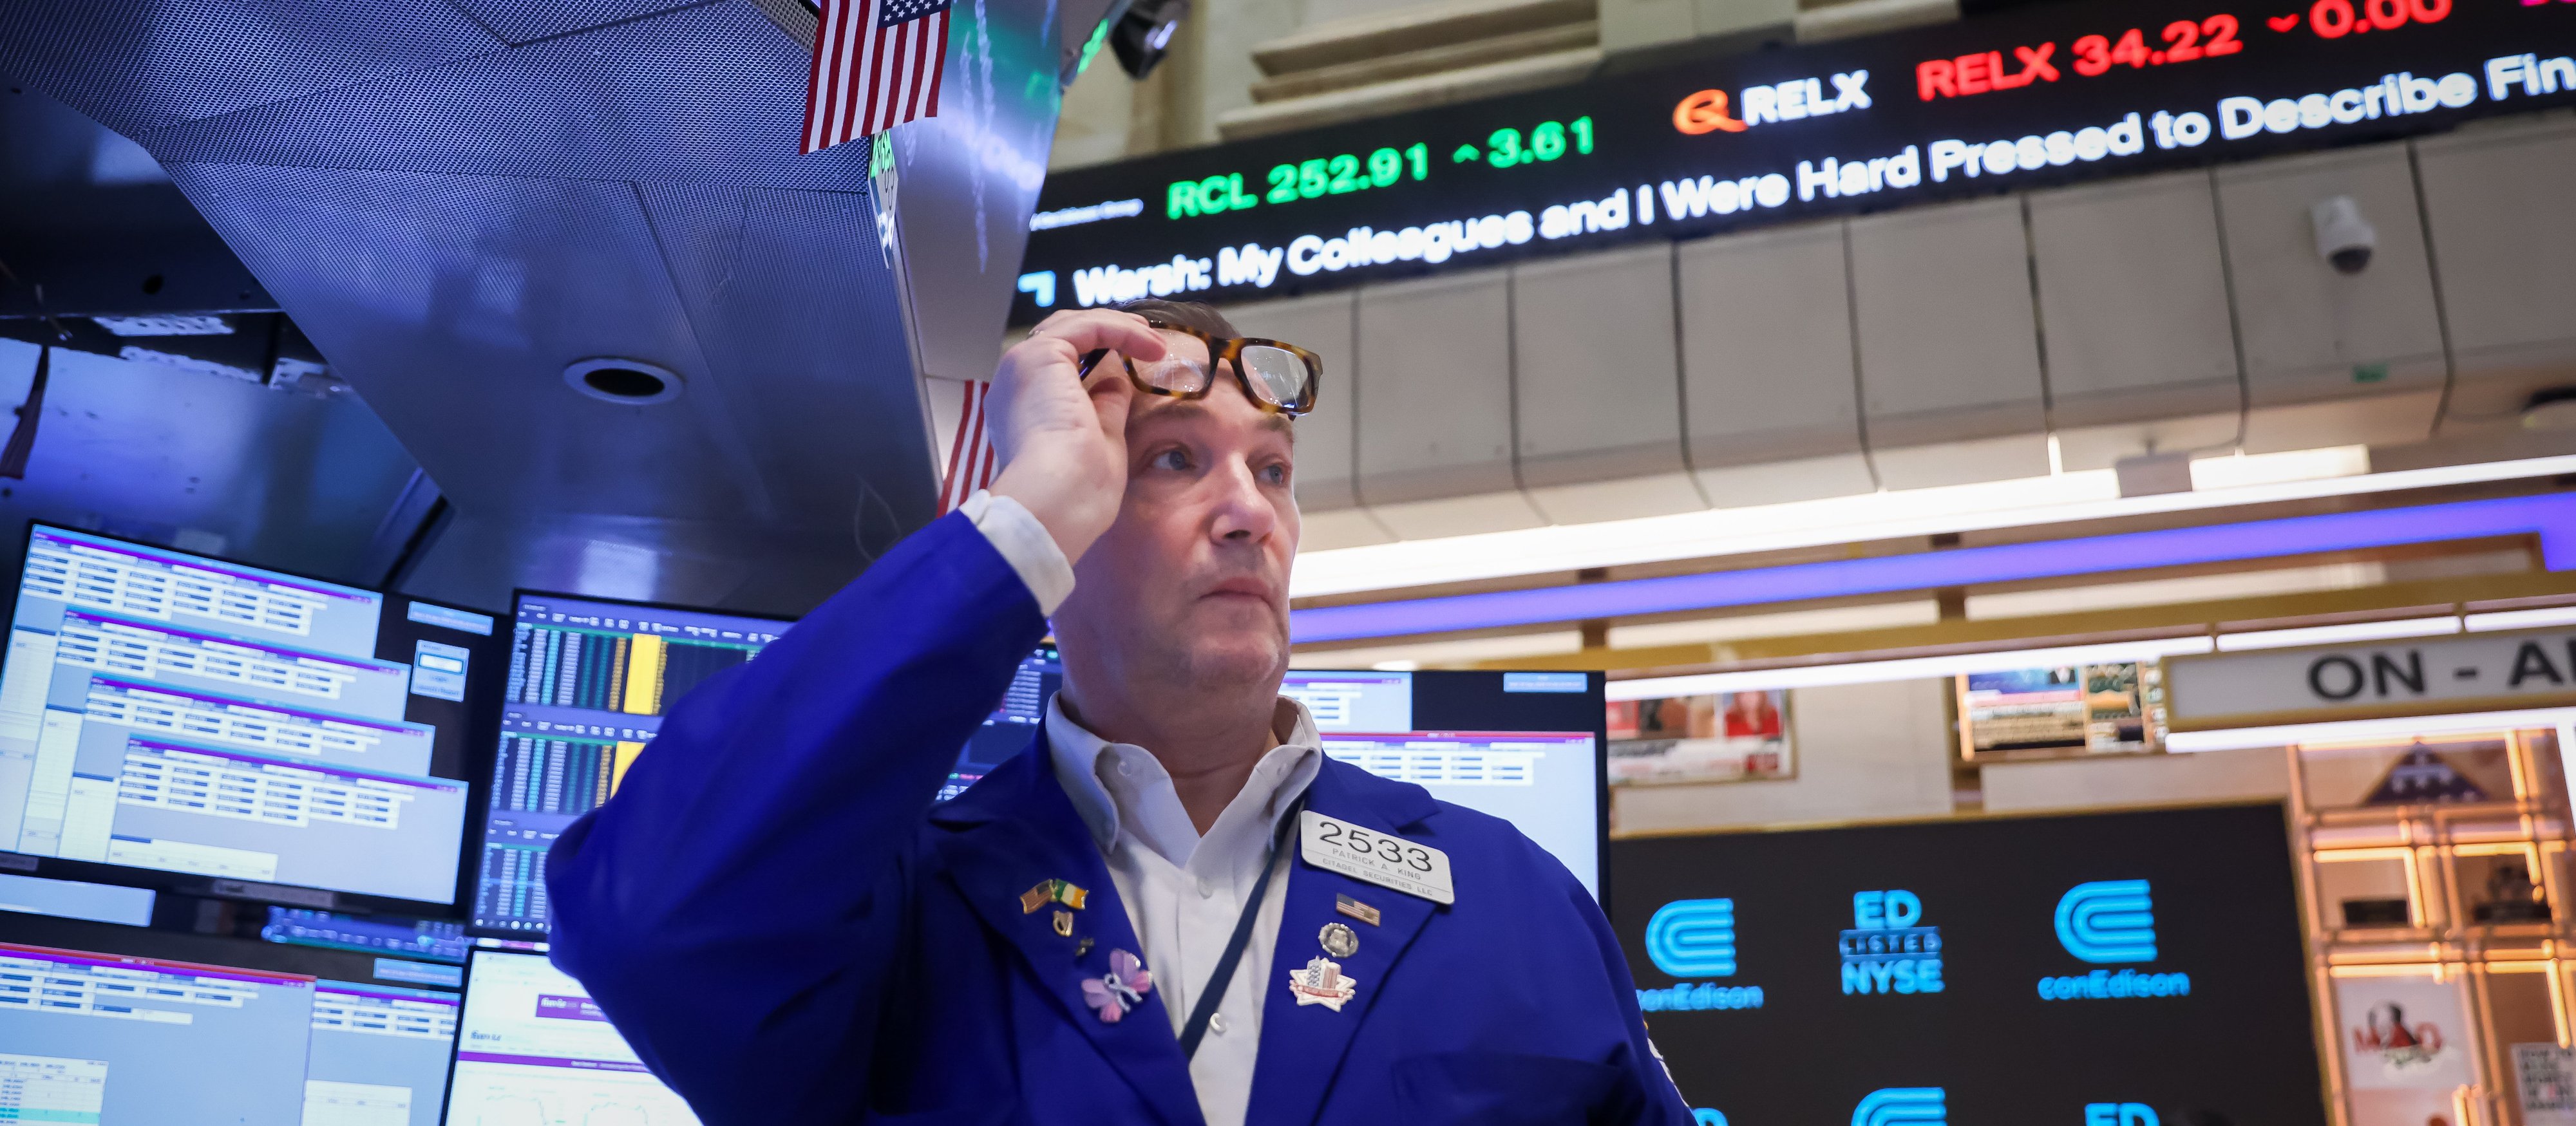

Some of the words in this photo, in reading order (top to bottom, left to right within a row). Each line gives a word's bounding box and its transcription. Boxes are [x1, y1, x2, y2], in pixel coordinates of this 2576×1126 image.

[1916, 41, 2060, 101] RELX
[2072, 14, 2242, 77] 34.22
[2309, 0, 2453, 39] 0.00
[1741, 70, 1872, 127] RELX
[1074, 255, 1212, 308] Warsh:
[1218, 243, 1283, 288] My
[1287, 211, 1533, 276] Colleagues
[1540, 184, 1630, 240] and
[1636, 185, 1654, 225] I
[1660, 173, 1791, 221] Were
[1795, 145, 1922, 202] Hard
[1929, 110, 2145, 182] Pressed
[2152, 110, 2211, 149] to
[2217, 71, 2478, 141] Describe
[2483, 52, 2576, 101] Fin
[1168, 173, 1258, 220] RCL
[1267, 142, 1428, 205] 252.91
[1488, 116, 1594, 169] 3.61
[2307, 649, 2428, 700] ON
[1319, 821, 1432, 872] 2533
[1332, 848, 1376, 866] PATRICK
[1397, 868, 1421, 880] KING
[1322, 858, 1359, 873] CITADEL
[1363, 870, 1412, 890] SECURITIES
[1417, 887, 1433, 896] LLC
[1853, 889, 1922, 929] ED
[1839, 933, 1942, 954] LISTED
[1841, 959, 1946, 995] NYSE
[2037, 968, 2191, 1000] conEdison
